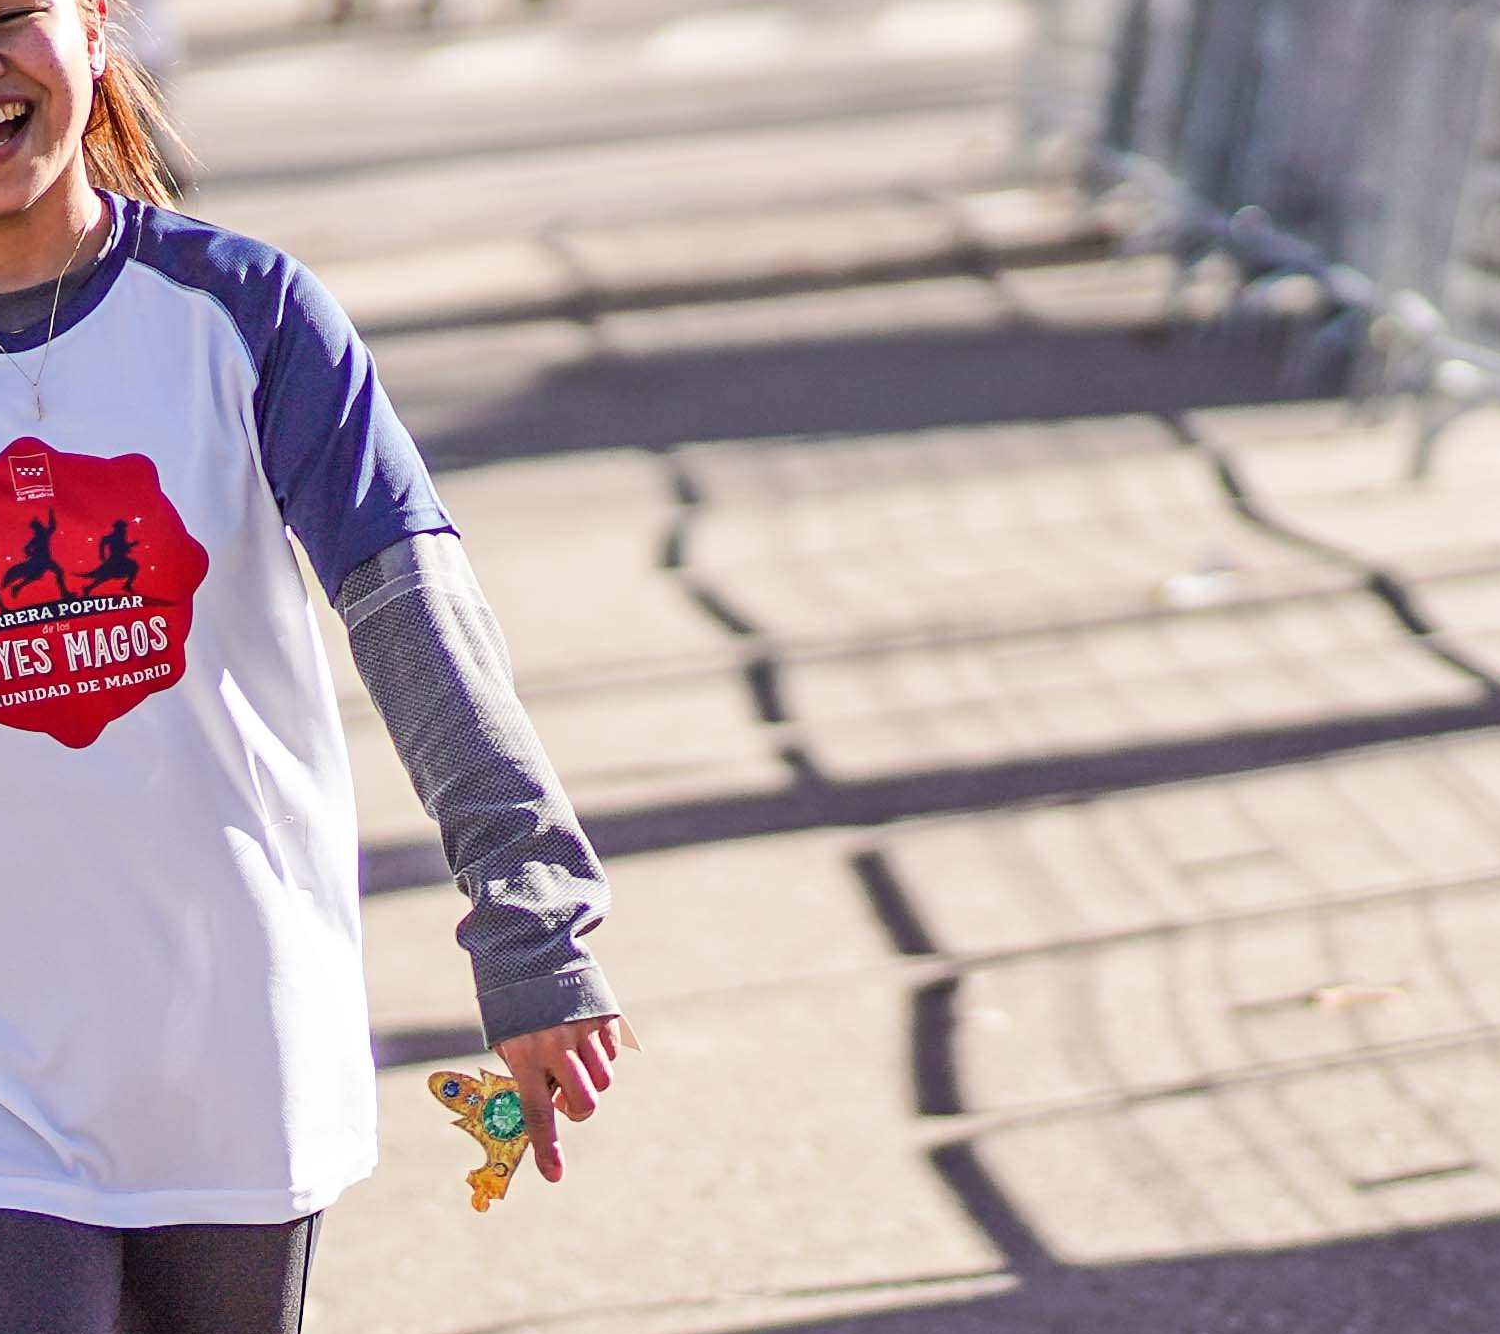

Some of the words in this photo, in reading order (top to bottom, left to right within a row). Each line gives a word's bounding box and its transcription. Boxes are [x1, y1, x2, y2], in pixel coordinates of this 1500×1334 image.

[58, 595, 143, 617] POPULAR
[42, 623, 54, 635] de
[56, 622, 70, 632] los
[63, 616, 168, 672] MAGOS
[77, 679, 101, 694] DE
[105, 663, 171, 689] MADRID
